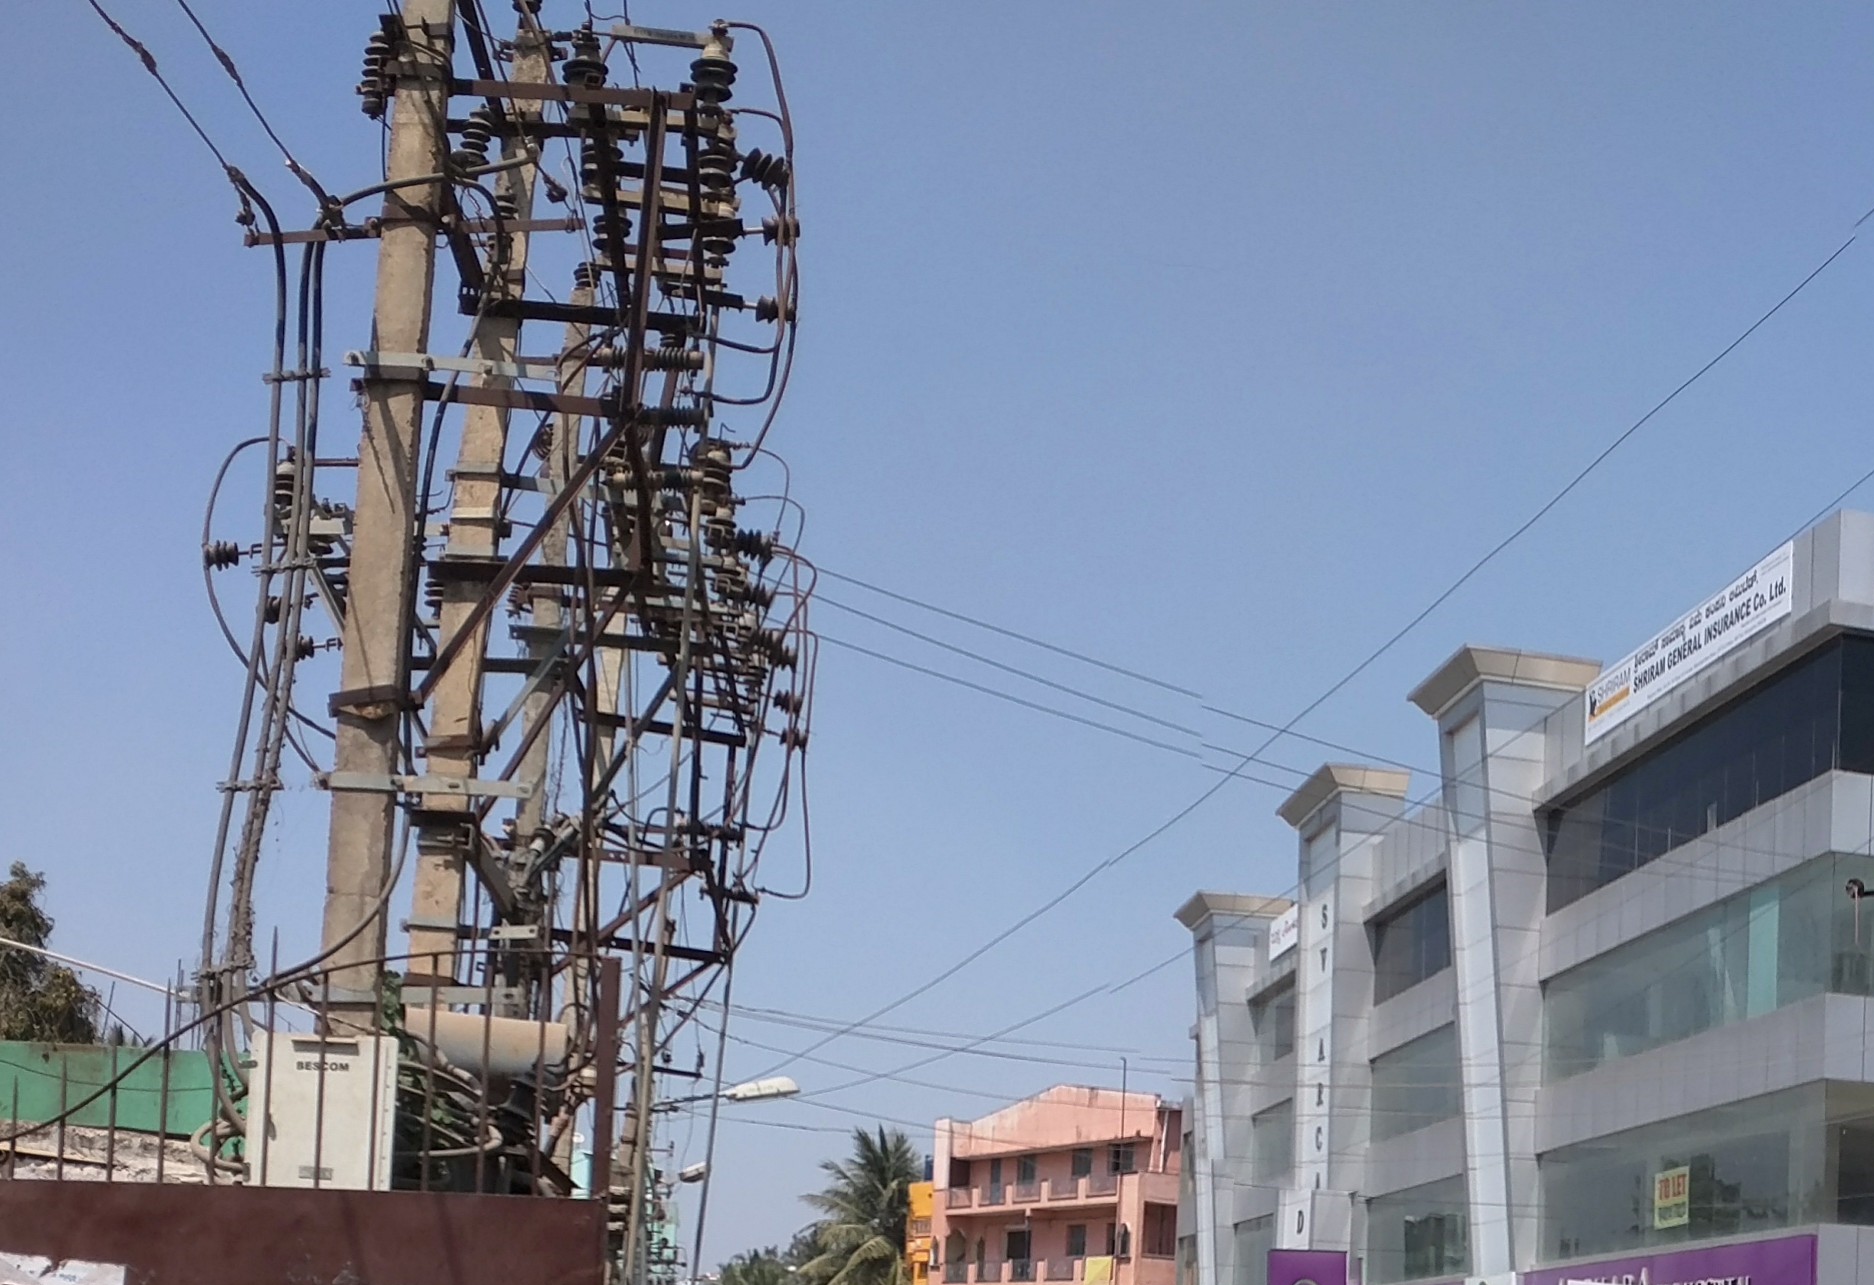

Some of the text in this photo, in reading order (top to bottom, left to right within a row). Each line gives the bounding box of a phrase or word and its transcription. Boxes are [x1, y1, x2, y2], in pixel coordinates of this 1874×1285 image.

[1633, 576, 1787, 694] SHRIRAM GENERAL INSURANCE Co. Ltd.
[1597, 668, 1632, 703] SHRIRAM
[296, 1060, 350, 1073] BESCOM
